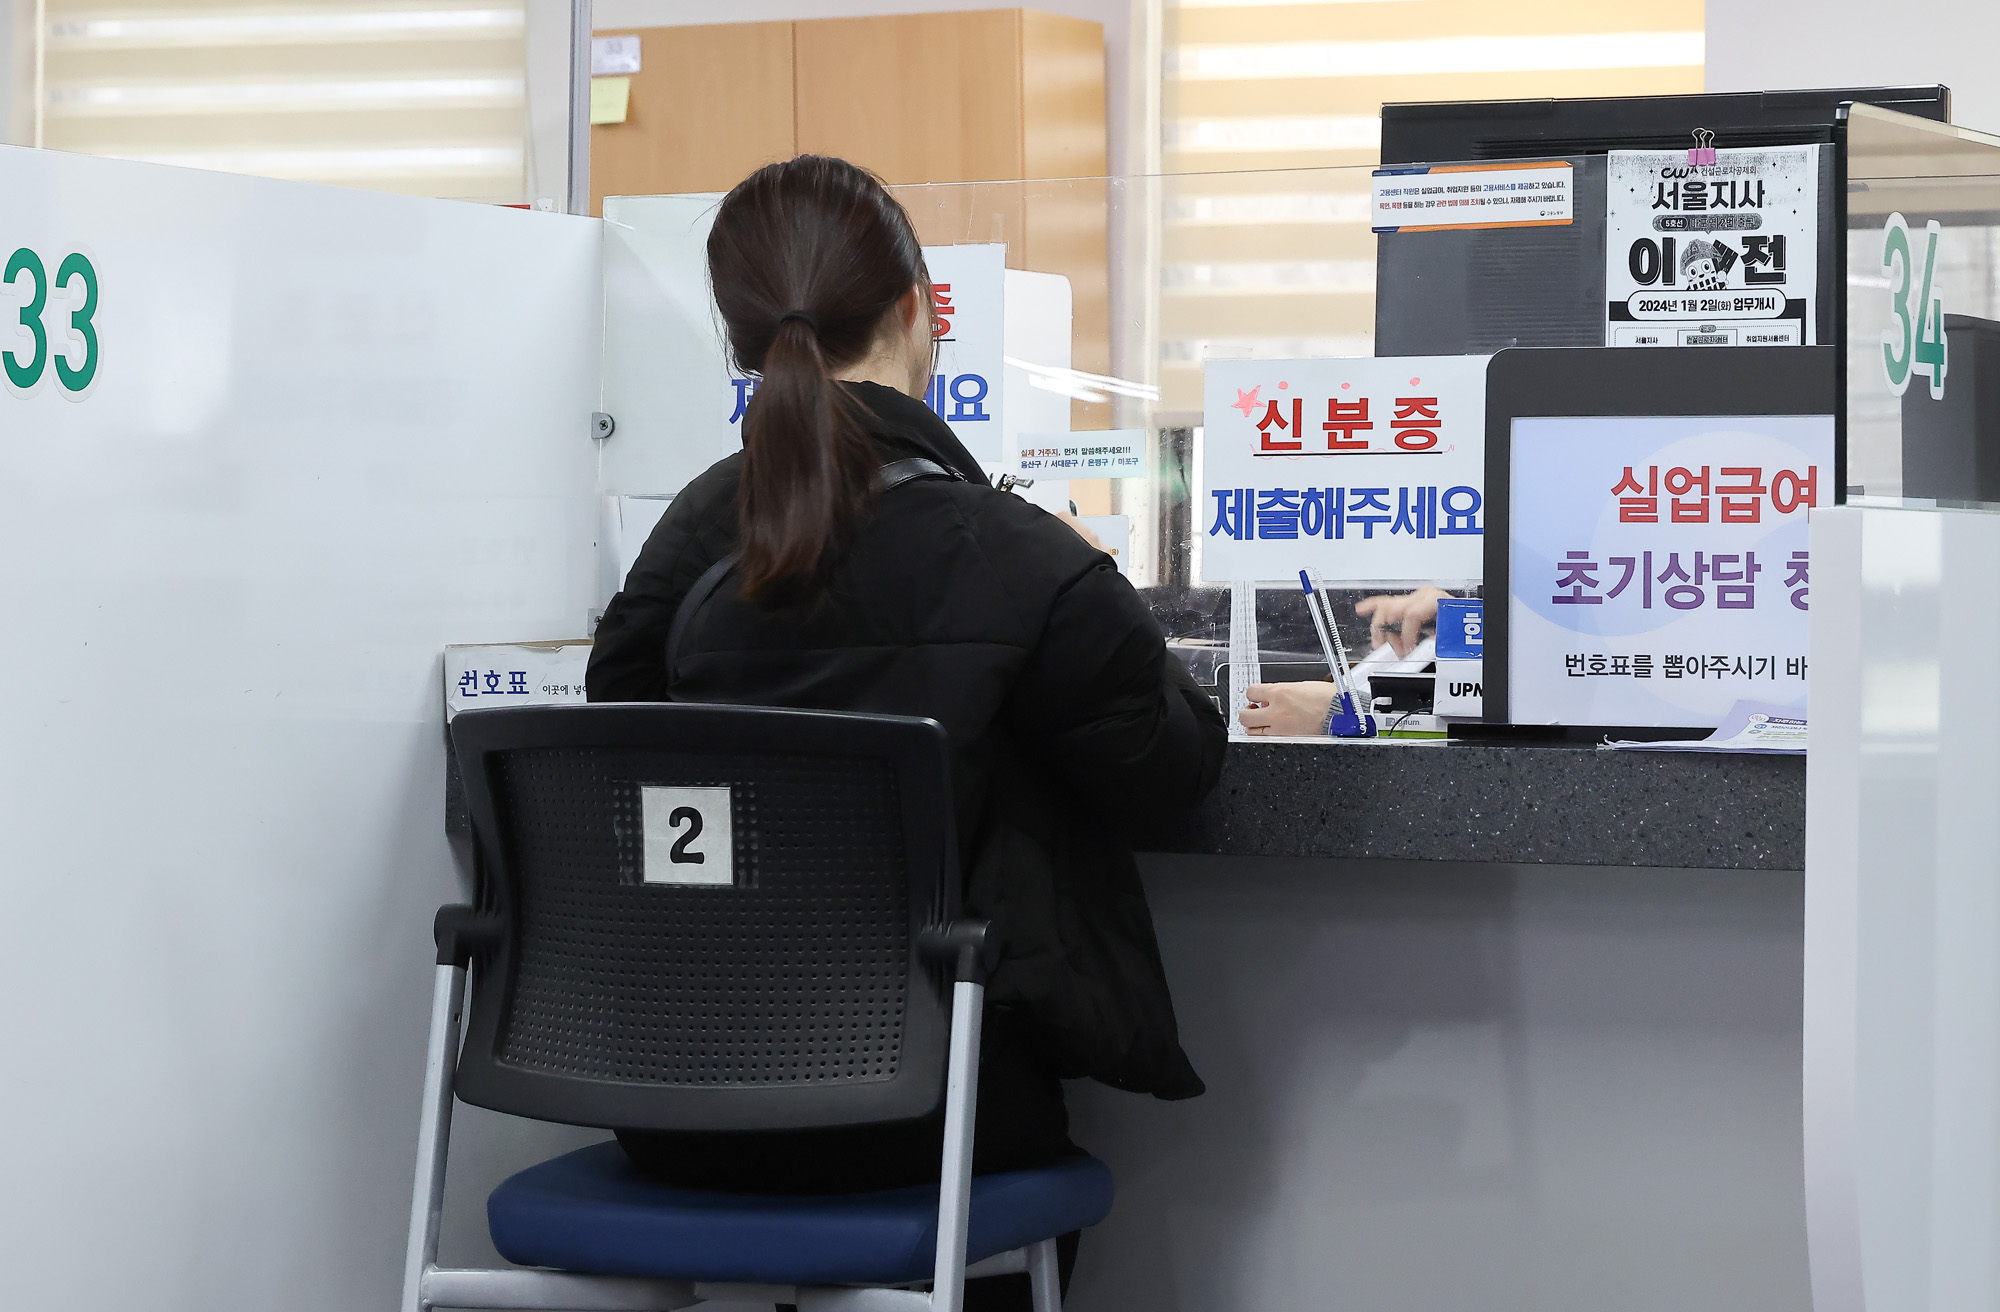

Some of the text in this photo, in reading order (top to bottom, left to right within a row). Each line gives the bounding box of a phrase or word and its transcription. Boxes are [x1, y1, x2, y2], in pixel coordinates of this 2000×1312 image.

[1517, 182, 1540, 191] 제공하고
[1527, 195, 1542, 204] 주시기
[1651, 180, 1765, 211] 서울지사
[1665, 219, 1684, 228] 5호선
[1639, 297, 1775, 312] 2024년 1월 2일(화) 업무개시
[1883, 225, 1945, 387] 34
[0, 247, 99, 392] 33
[1020, 448, 1035, 457] 실제
[1064, 447, 1078, 456] 먼저
[1081, 446, 1131, 456] 말씀해주세요!!!
[1020, 459, 1042, 469] 용산구
[1050, 459, 1078, 468] 서대문구
[1087, 458, 1109, 467] 은평구
[1117, 457, 1139, 466] 마포구
[1611, 465, 1817, 524] 실업급여
[1209, 485, 1484, 541] 제출해주세요
[1551, 550, 1762, 611] 초기상담
[1565, 653, 1653, 680] 번호표를
[1663, 653, 1776, 680] 뽑아주시기
[458, 669, 530, 697] 번호표
[542, 684, 569, 696] 이곳에
[669, 806, 705, 864] 2
